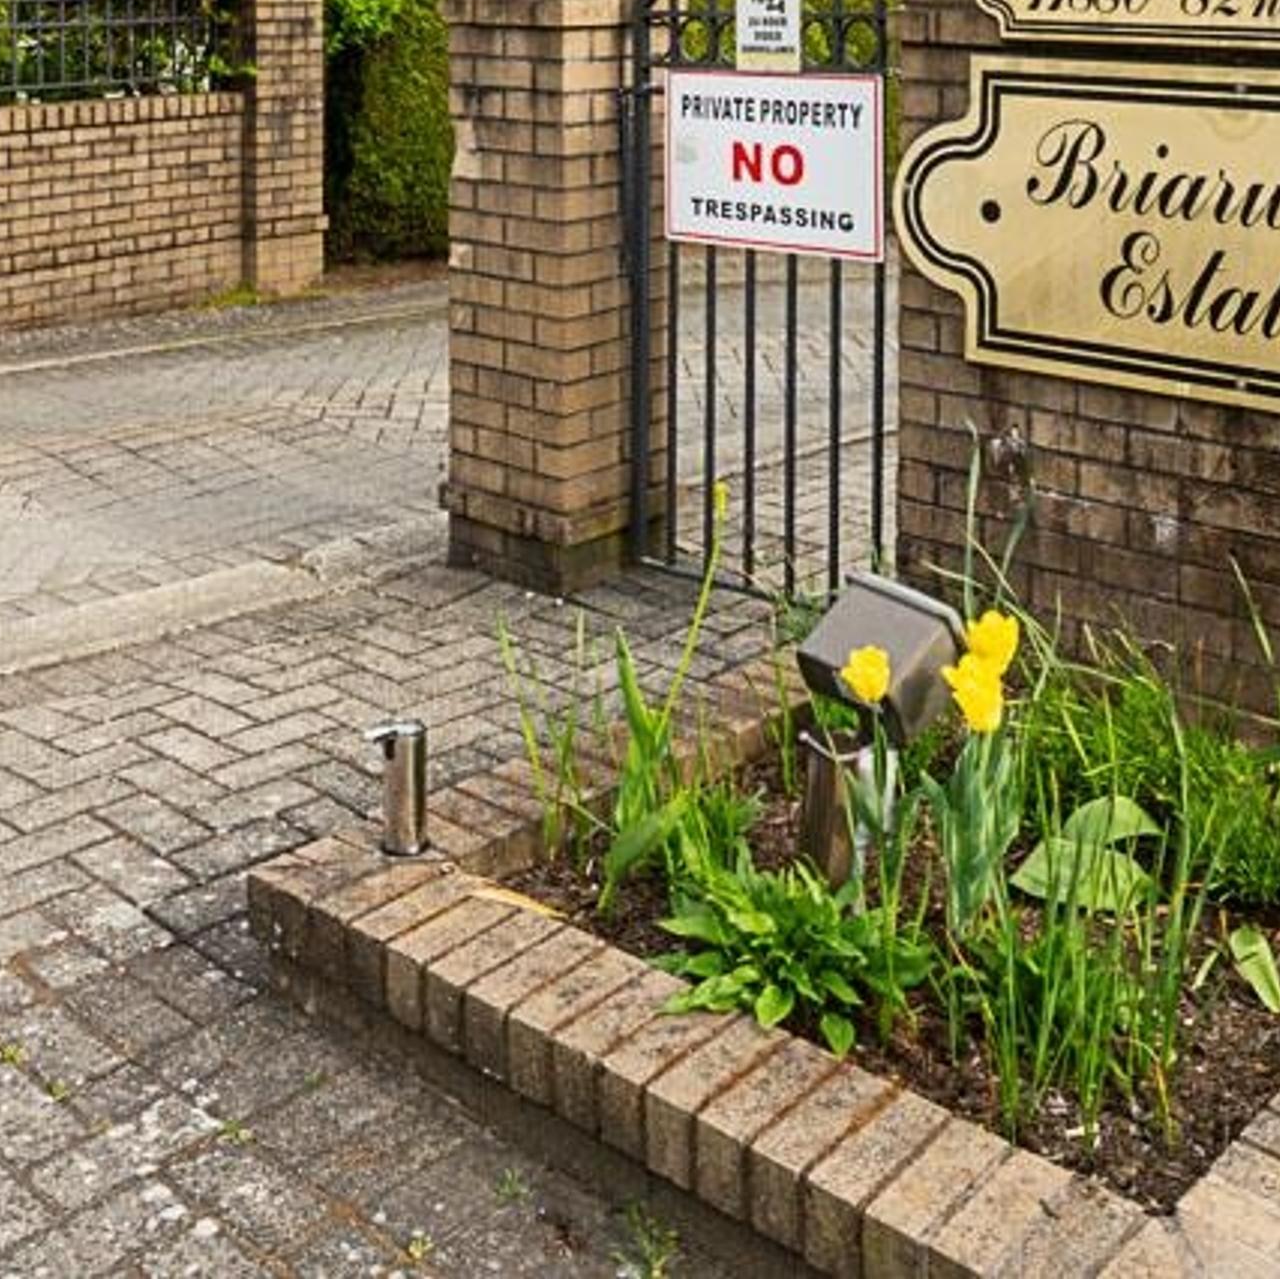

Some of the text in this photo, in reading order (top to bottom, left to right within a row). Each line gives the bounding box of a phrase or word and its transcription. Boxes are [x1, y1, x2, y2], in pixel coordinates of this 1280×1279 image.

[682, 94, 863, 129] PRIVATE PROPERTY
[733, 141, 804, 186] NO
[692, 198, 854, 232] TRESPASSING
